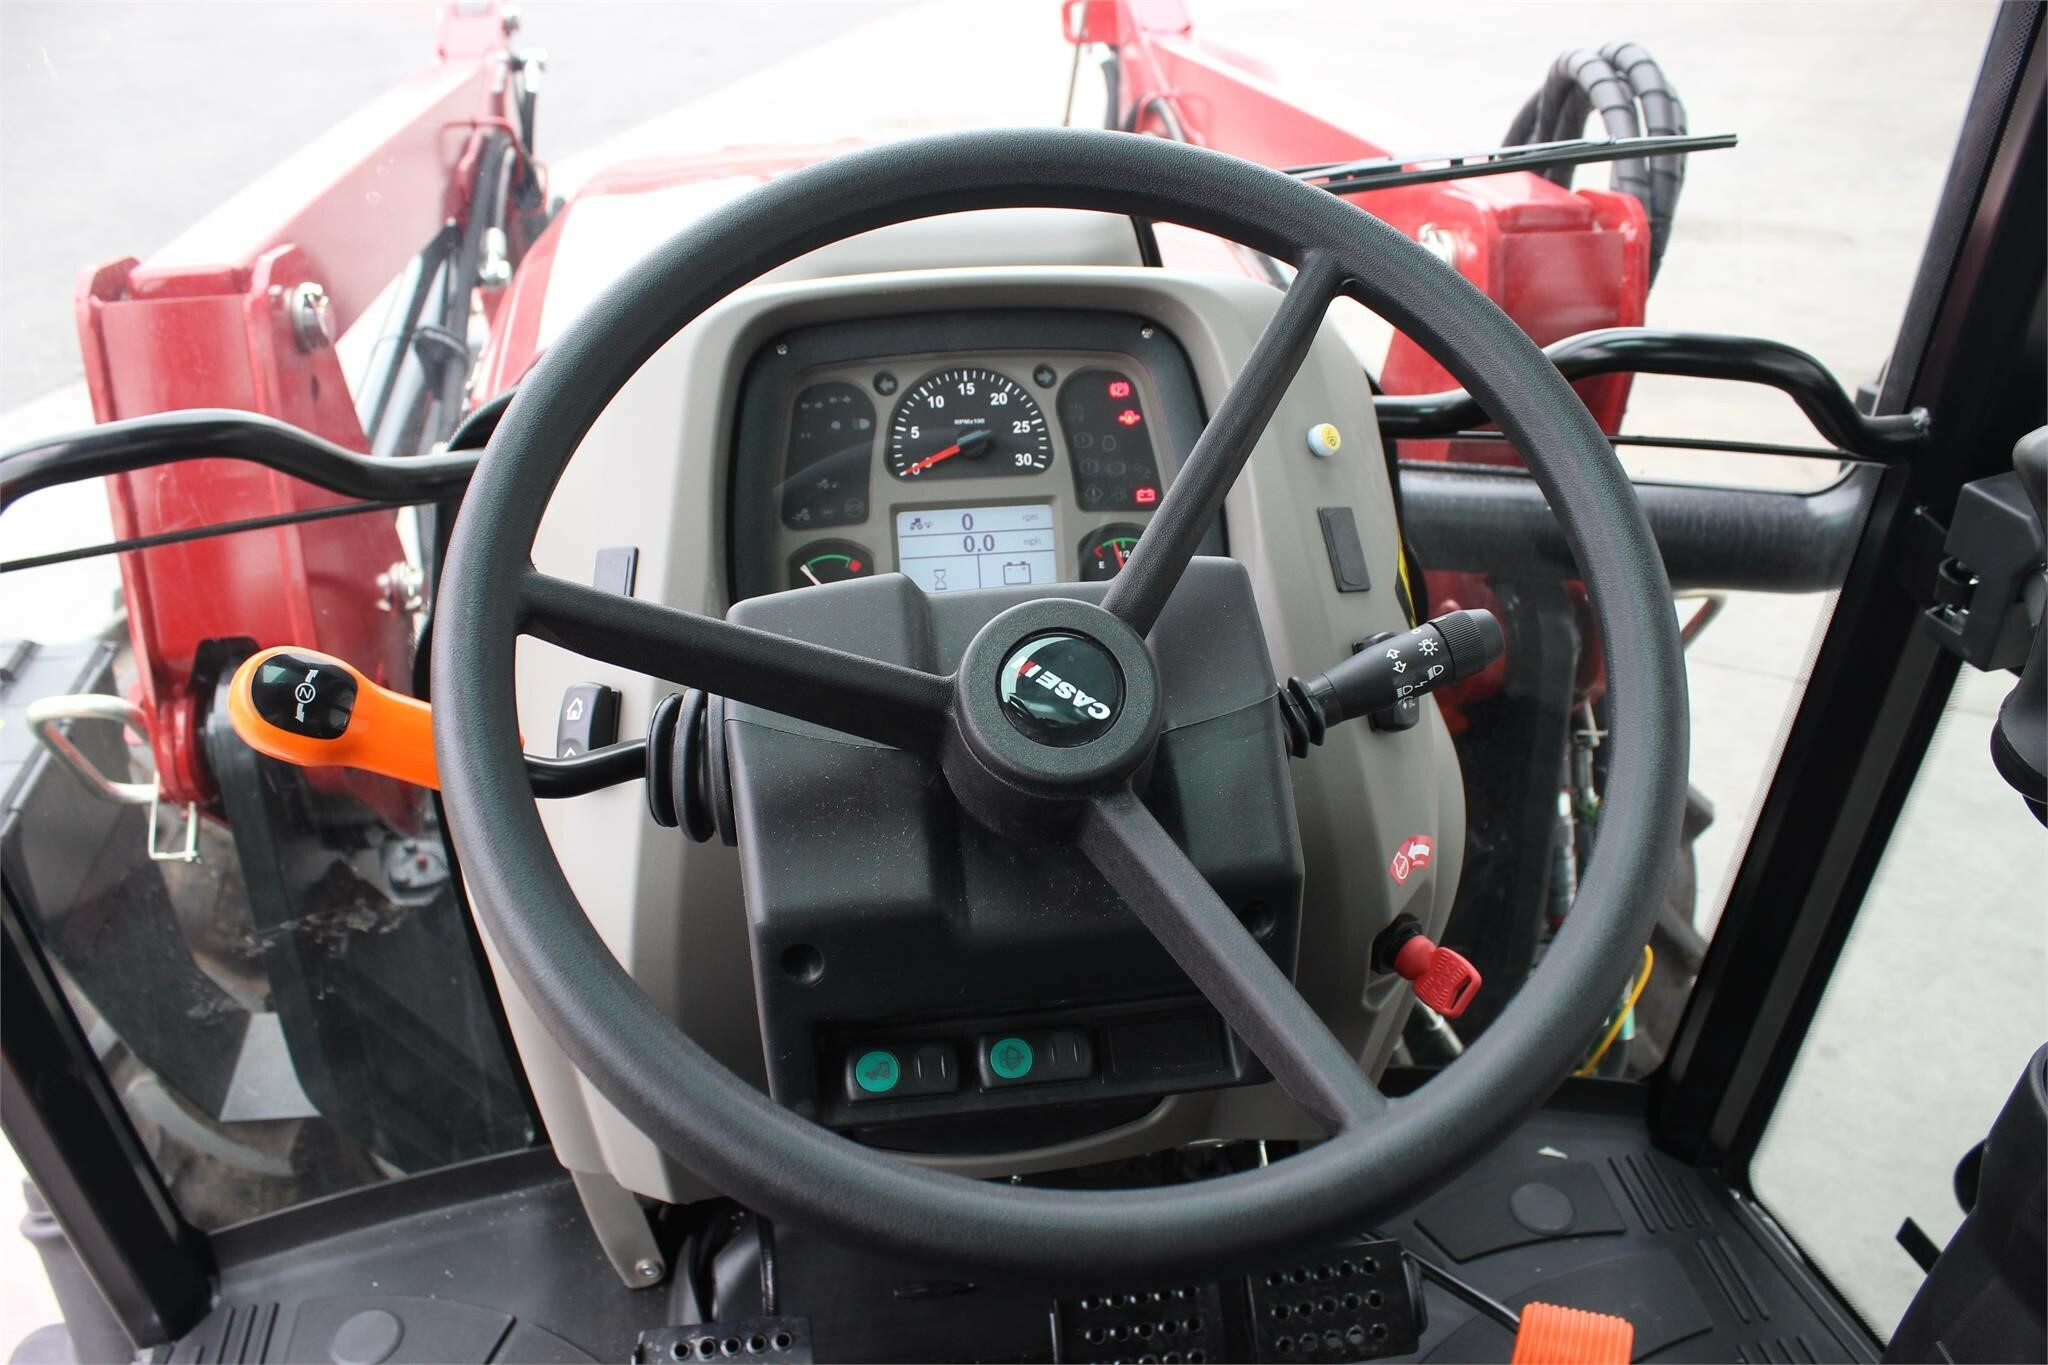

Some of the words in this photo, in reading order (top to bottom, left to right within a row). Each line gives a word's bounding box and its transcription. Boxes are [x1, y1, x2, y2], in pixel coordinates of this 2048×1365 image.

[958, 382, 975, 395] 15
[927, 395, 945, 408] 10
[990, 393, 1008, 406] 20
[910, 426, 920, 439] 5
[1012, 421, 1030, 433] 25
[1014, 453, 1032, 466] 30
[961, 513, 973, 530] 0
[1022, 514, 1039, 522] rpm
[963, 534, 995, 552] 0.0
[1024, 536, 1041, 546] mph
[1098, 561, 1105, 569] E
[299, 687, 311, 699] N
[1035, 670, 1111, 720] CASE
